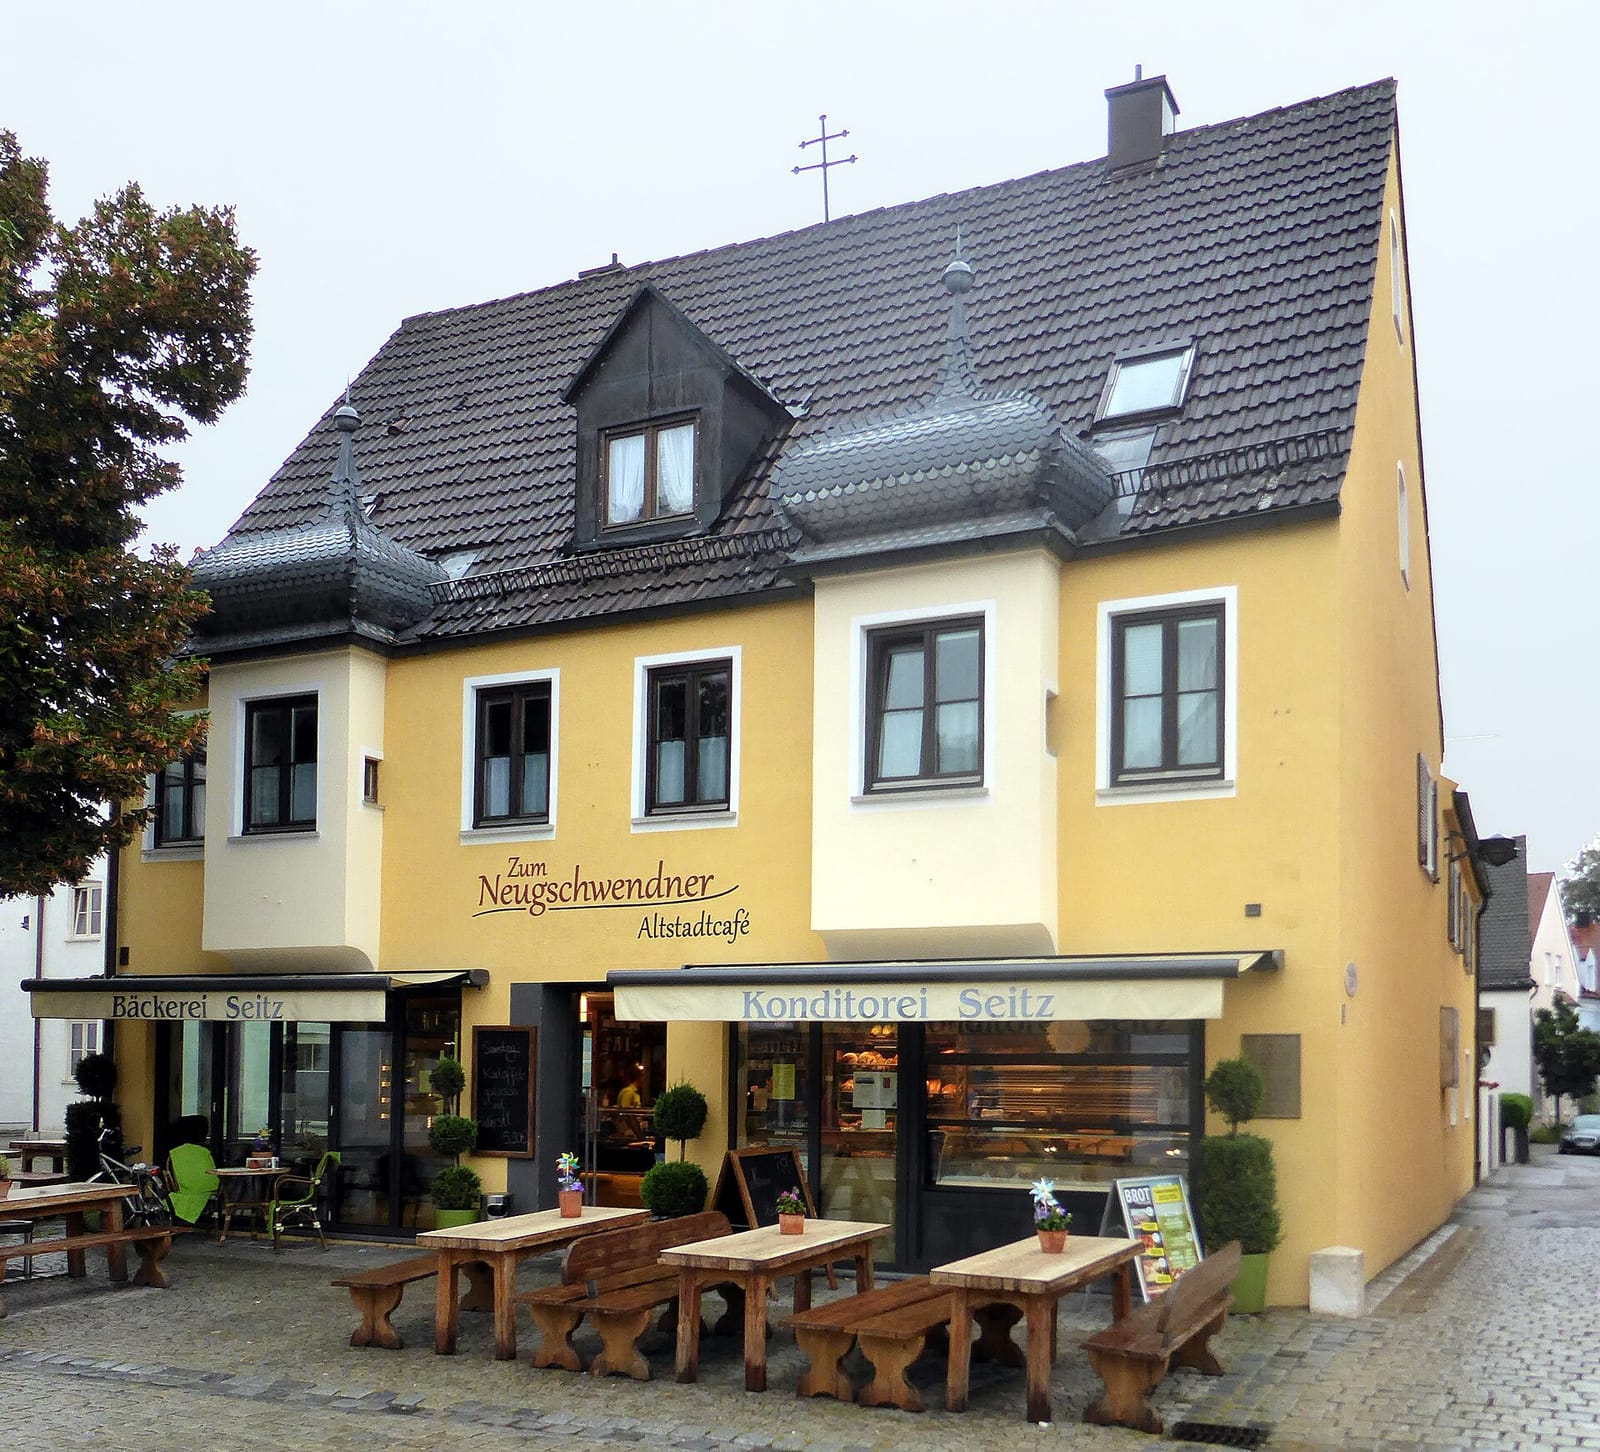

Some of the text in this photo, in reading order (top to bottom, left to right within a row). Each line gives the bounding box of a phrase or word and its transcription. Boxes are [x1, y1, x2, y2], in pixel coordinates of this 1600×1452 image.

[507, 857, 548, 878] Zum
[479, 860, 715, 916] Neugschwendner
[637, 908, 750, 944] Altstadtcafé
[111, 994, 284, 1019] Bäckerei Seitz
[742, 986, 1055, 1019] Konditorei Seitz
[1124, 1187, 1151, 1203] BROT
